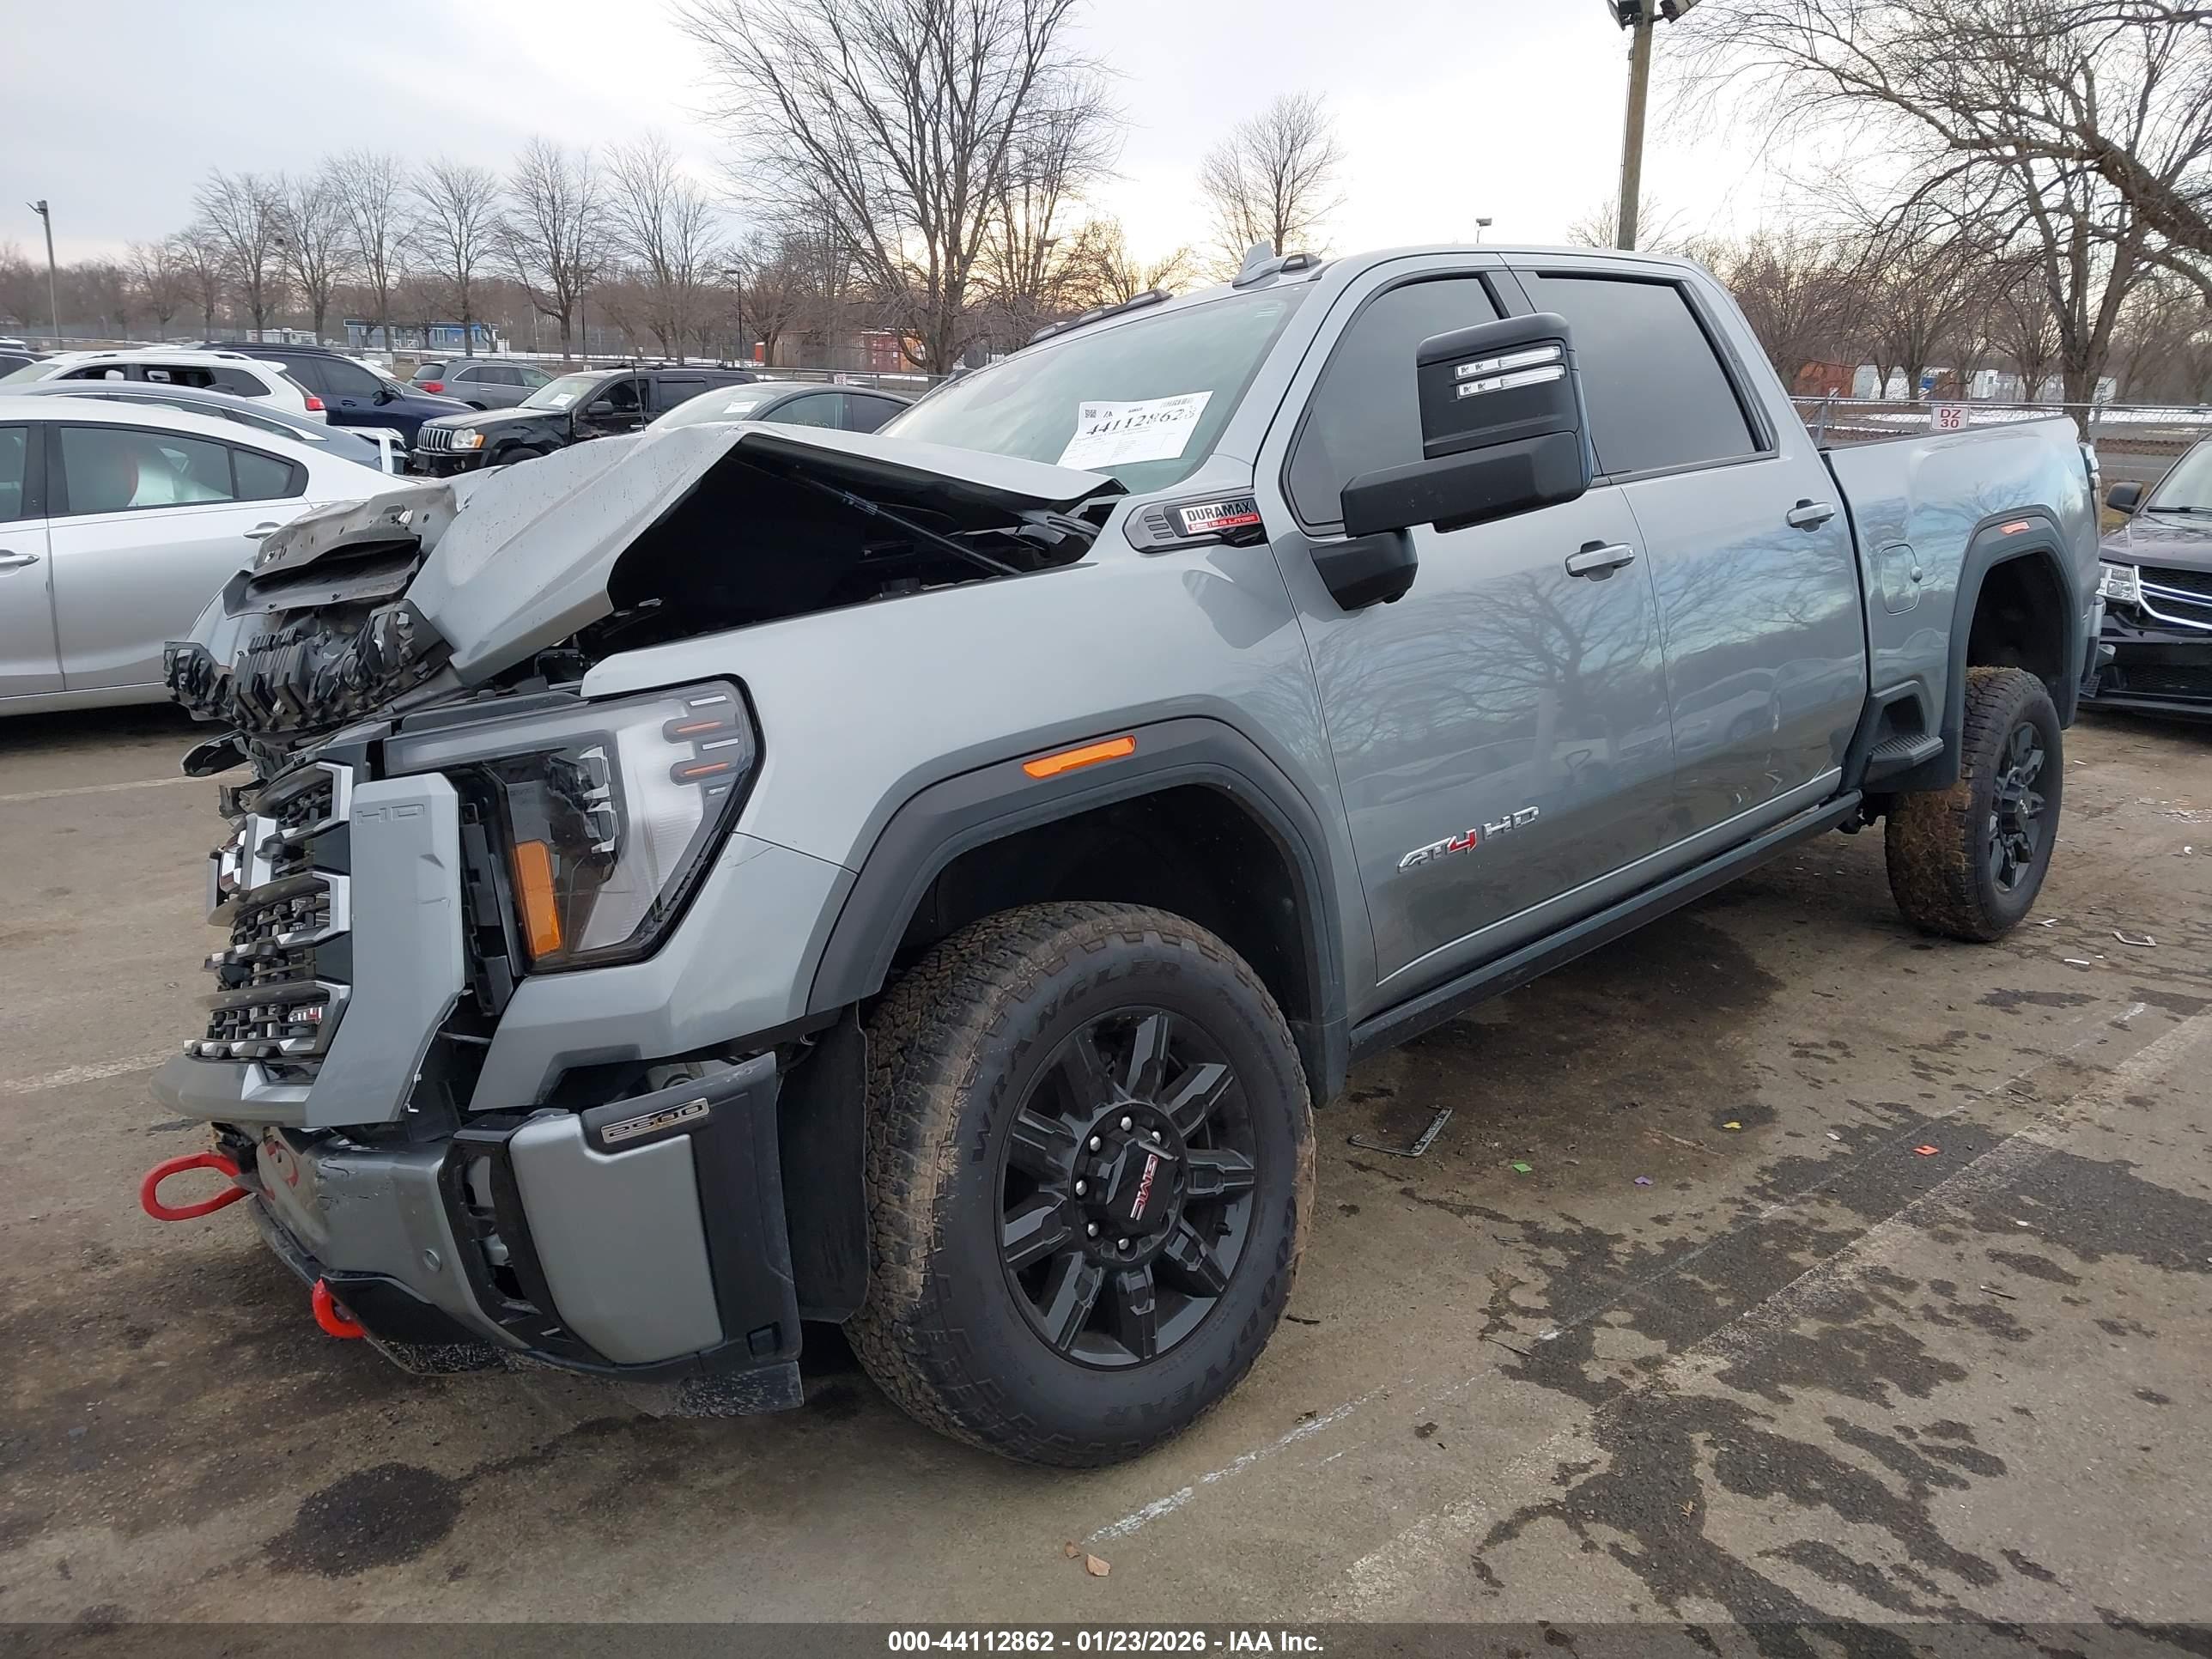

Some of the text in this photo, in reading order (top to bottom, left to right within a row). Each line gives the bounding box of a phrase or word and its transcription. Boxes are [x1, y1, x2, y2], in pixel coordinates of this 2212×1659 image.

[1940, 409, 1961, 419] DZ
[1940, 418, 1960, 428] 30
[1186, 501, 1254, 522] DURAMAX
[356, 804, 425, 825] HD
[1398, 805, 1540, 872] AT4 HD
[969, 957, 1182, 1164] WRANGLER
[609, 1103, 703, 1138] 2500
[1130, 1153, 1158, 1220] GMC
[1105, 1194, 1297, 1426] GOODYEAR
